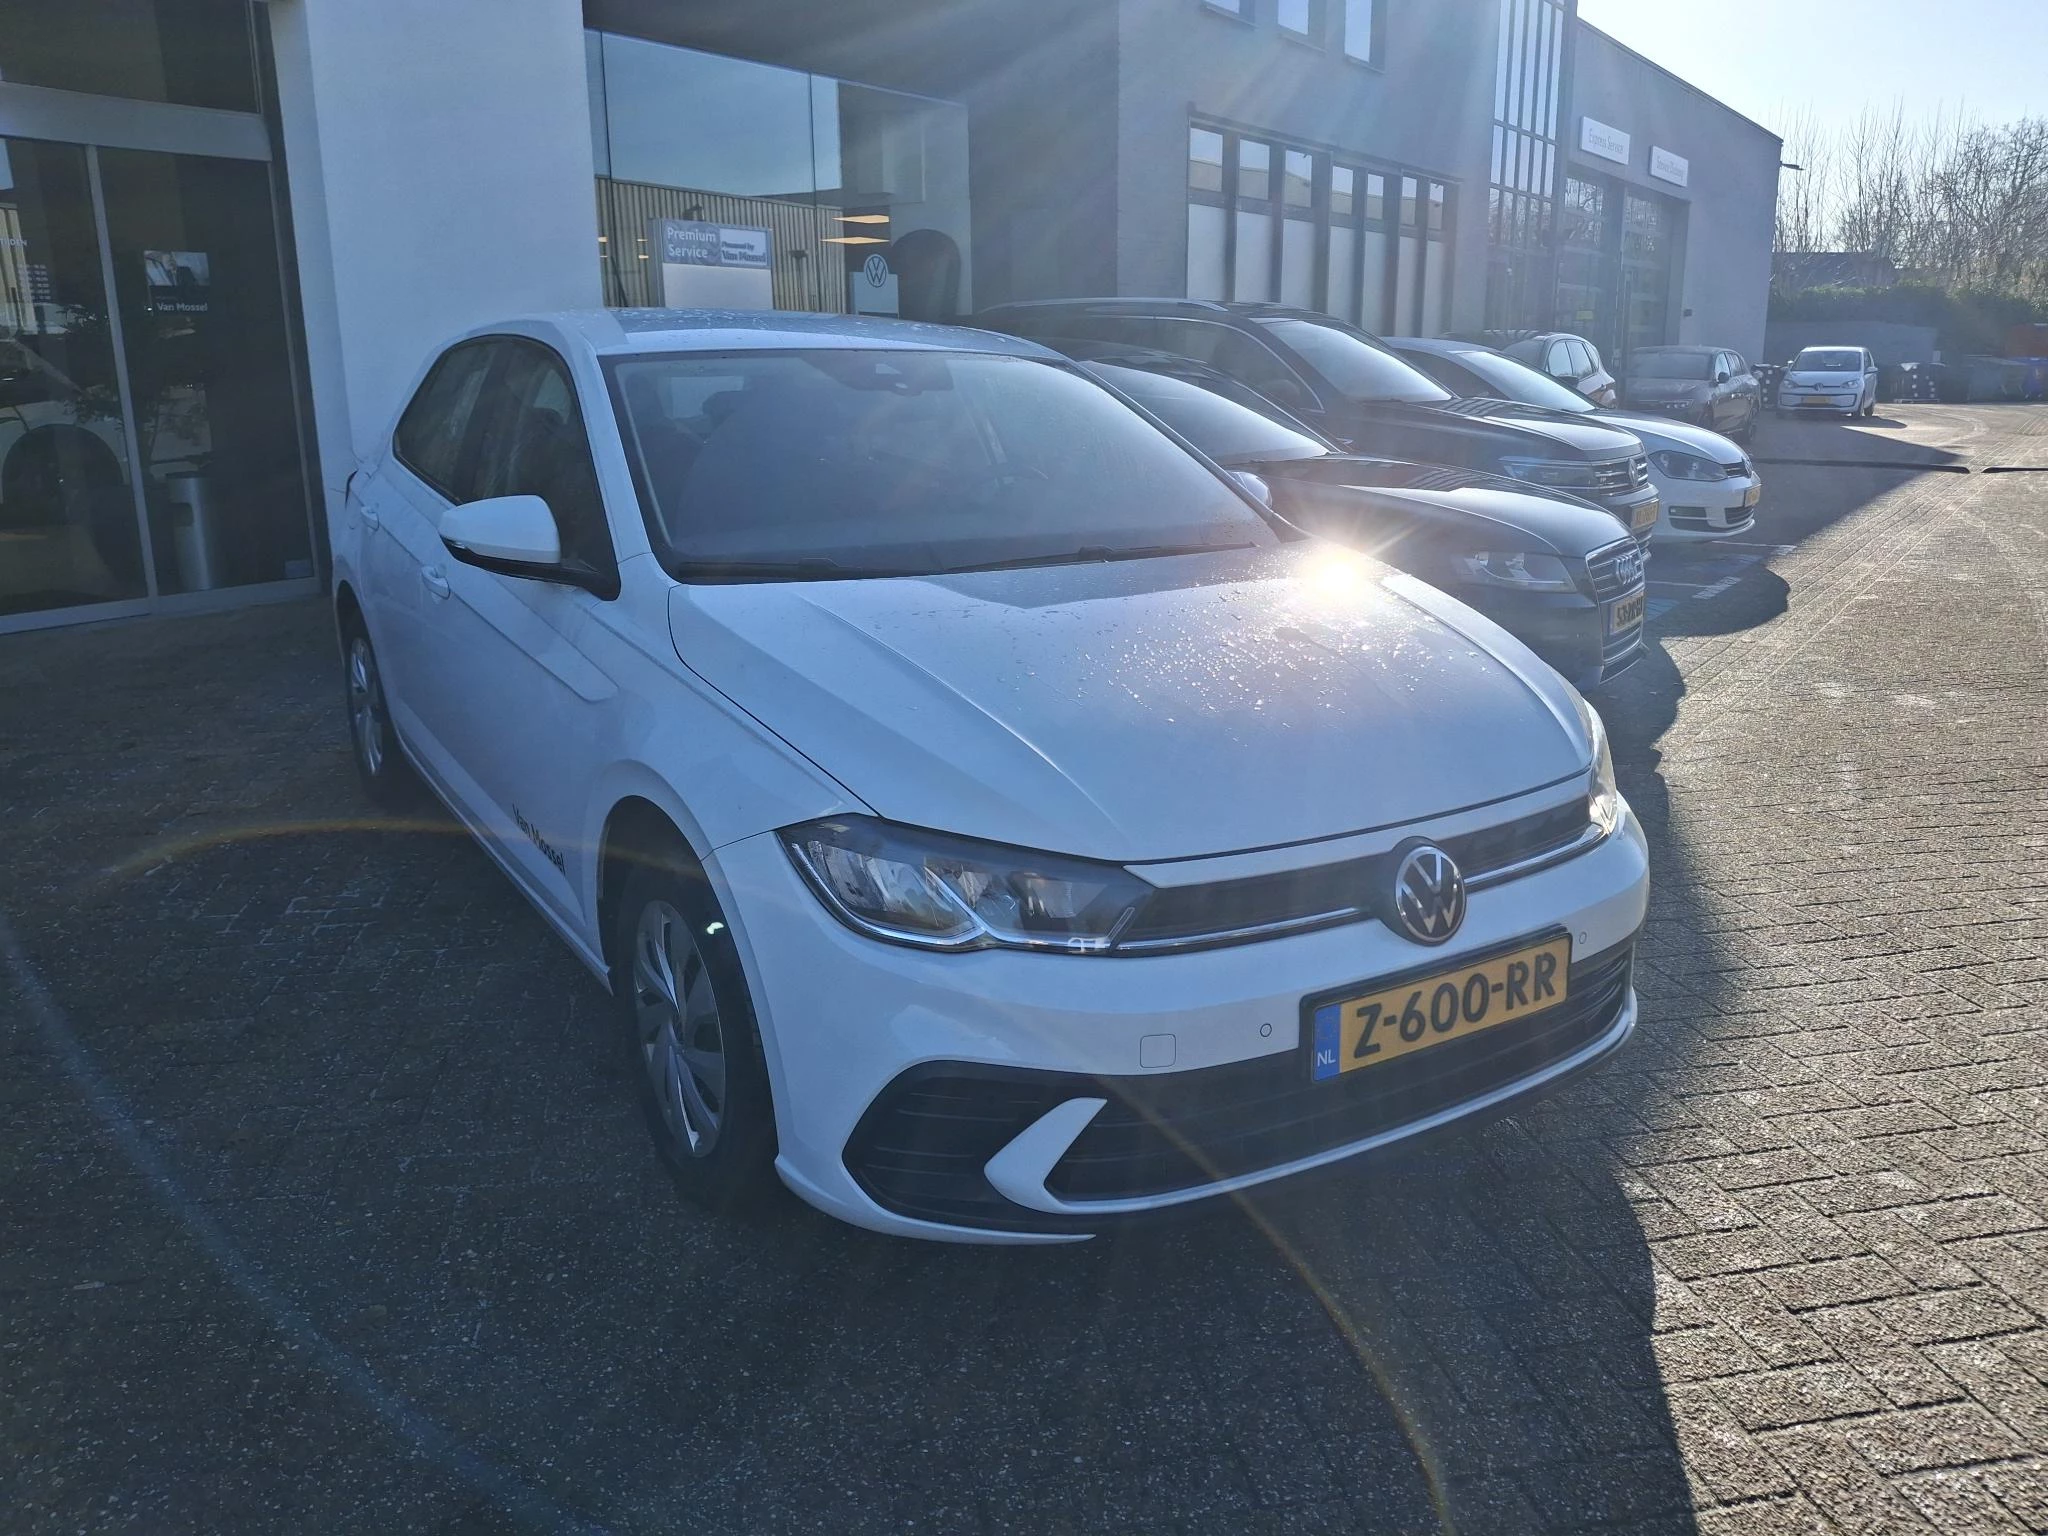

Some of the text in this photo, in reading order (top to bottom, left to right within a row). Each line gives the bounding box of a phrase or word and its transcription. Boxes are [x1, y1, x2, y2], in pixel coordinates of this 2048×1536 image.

[667, 227, 716, 243] Premium
[668, 244, 708, 258] Service
[721, 250, 738, 260] Van
[156, 302, 208, 311] Van Mossel
[512, 803, 566, 876] Van Mossel
[1352, 951, 1558, 1059] Z-600-RR
[1316, 1049, 1336, 1067] NL
